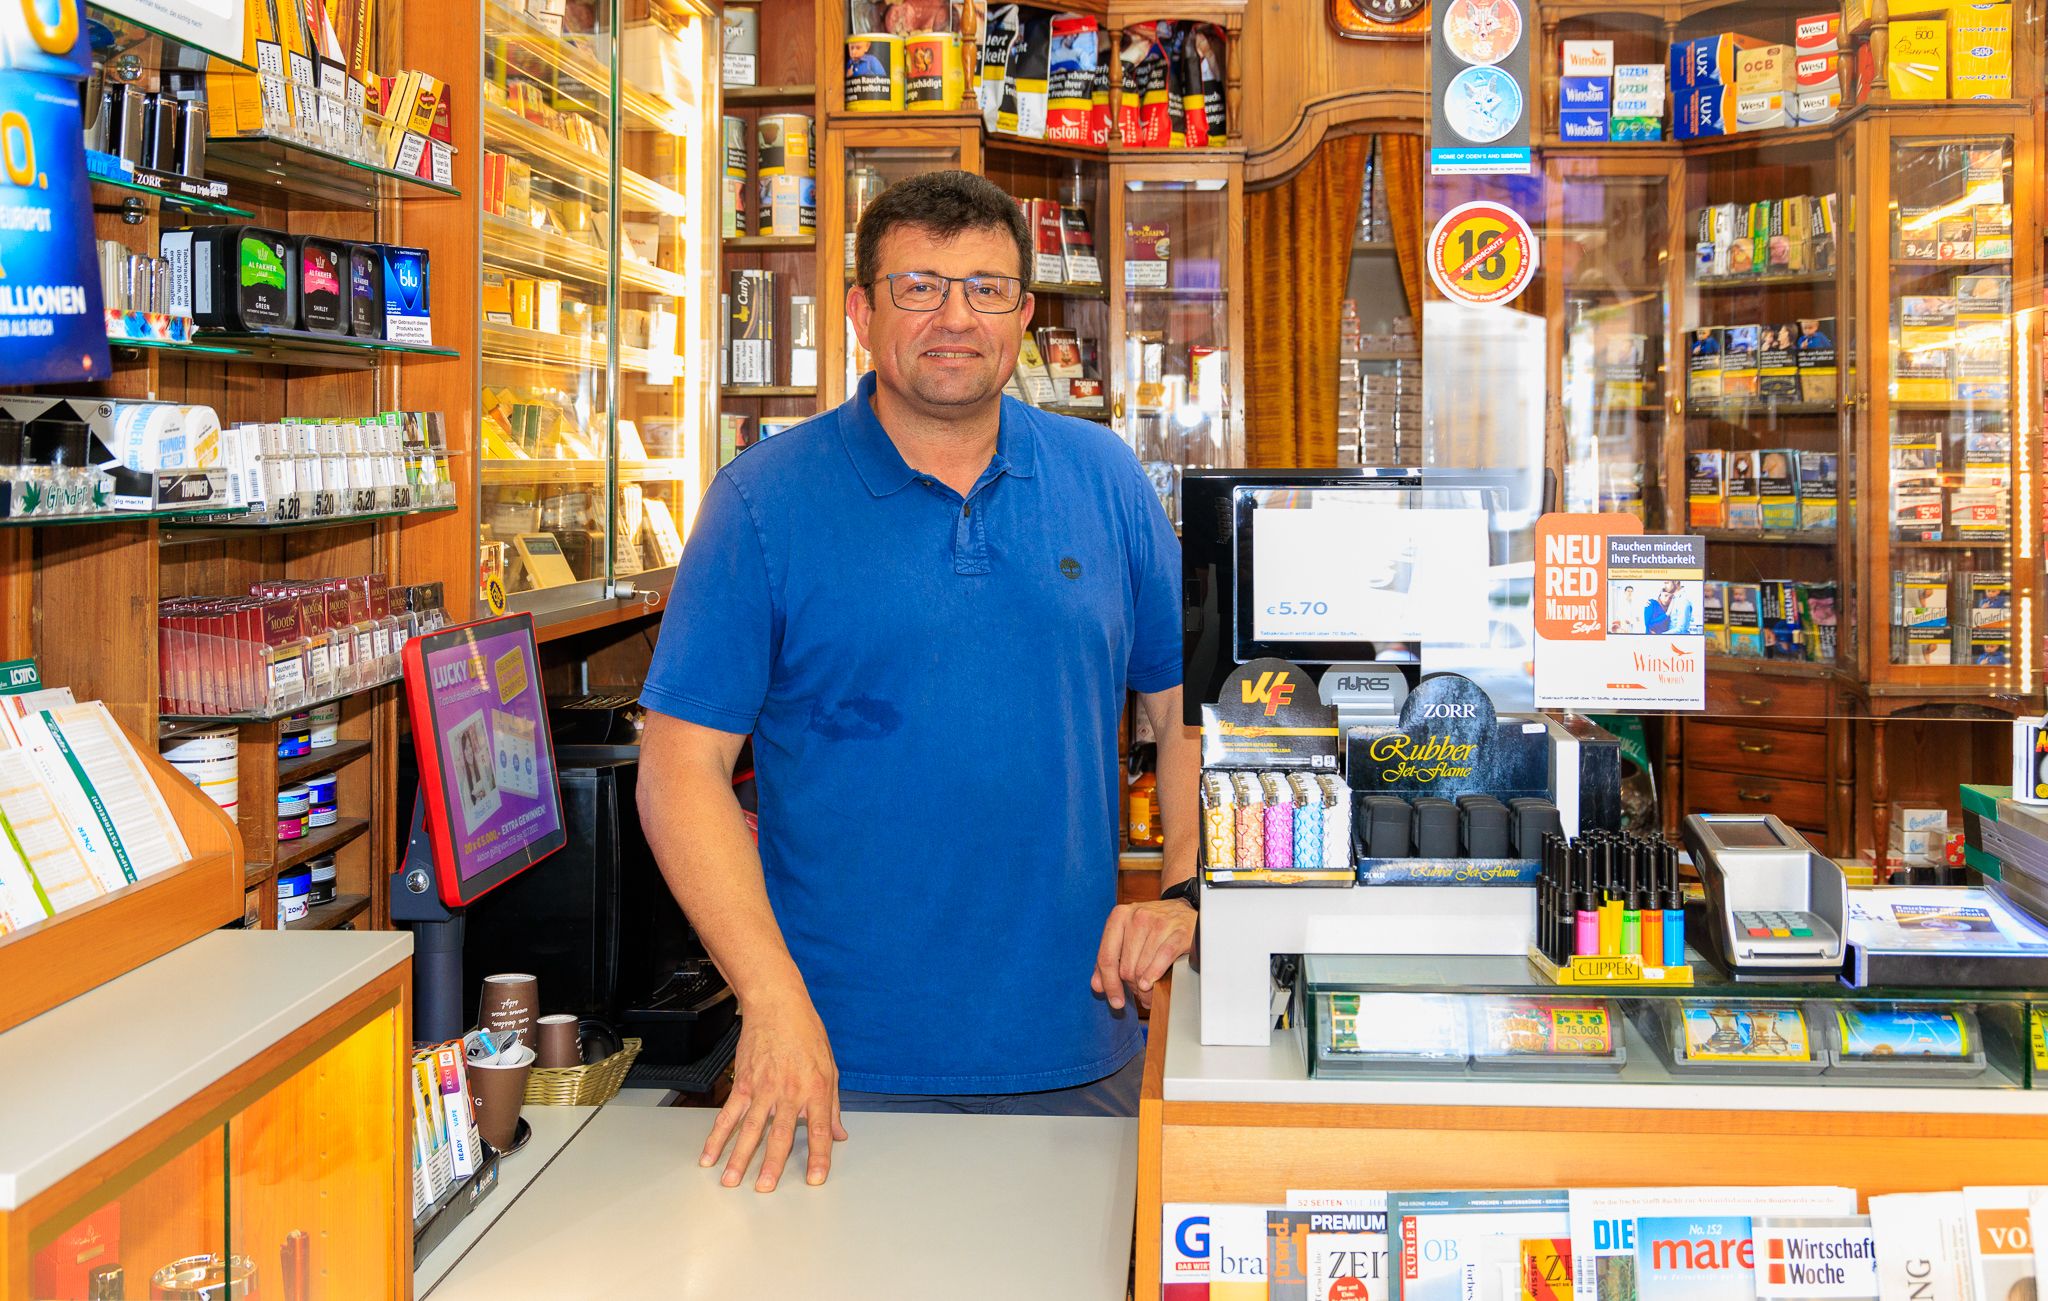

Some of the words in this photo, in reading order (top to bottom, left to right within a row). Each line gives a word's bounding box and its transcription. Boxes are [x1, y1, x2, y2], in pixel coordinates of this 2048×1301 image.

[1800, 22, 1825, 35] West
[1569, 53, 1607, 66] Winston
[1696, 46, 1708, 78] LUX
[1744, 60, 1774, 73] OCB
[1800, 61, 1824, 73] West
[1618, 67, 1649, 77] GIZEH
[861, 76, 891, 85] Rauchern
[862, 84, 881, 93] selbst
[881, 85, 890, 93] zu
[912, 78, 943, 89] schädigt
[1618, 83, 1648, 94] GIZEH
[1565, 87, 1605, 102] Winston
[1617, 99, 1647, 110] GIZEH
[1700, 95, 1712, 126] LUX
[1740, 99, 1766, 111] West
[1802, 98, 1825, 109] West
[1565, 122, 1604, 137] Winston
[136, 172, 162, 188] ZORR
[1437, 231, 1449, 247] Kein
[1436, 246, 1446, 272] Verkauf
[1458, 229, 1507, 281] 18
[1460, 237, 1505, 274] JUGENDSCHUTZ
[248, 261, 257, 270] AL
[257, 261, 277, 272] FAKHER
[394, 260, 407, 275] my
[399, 269, 418, 288] blu
[737, 275, 751, 305] Curly
[255, 302, 270, 311] GREEN
[258, 295, 267, 303] BIG
[398, 318, 415, 327] Gebrauch
[46, 484, 89, 510] Grinder
[1545, 534, 1601, 565] NEU
[1611, 541, 1652, 552] Rauchen
[1653, 541, 1693, 552] mindert
[1611, 554, 1630, 564] Ihre
[1632, 554, 1696, 565] Fruchtbarkeit
[1545, 566, 1599, 596] RED
[1279, 601, 1329, 615] 5.70
[1784, 587, 1795, 625] DRUM
[271, 615, 296, 631] MOODS
[1633, 650, 1695, 673] Winston
[10, 666, 38, 687] LOTTO
[433, 659, 467, 689] LUCKY
[1337, 676, 1390, 691] AURES
[1423, 703, 1477, 718] ZORR
[1369, 733, 1477, 762] Rubber
[1382, 761, 1473, 783] Jet-Flame
[90, 795, 119, 847] ÖSTERREICH!
[501, 819, 519, 835] EXTRA
[518, 804, 547, 827] GEWINNEN!
[76, 826, 97, 854] JOKER
[116, 848, 131, 873] TIPPT
[1410, 865, 1454, 878] Rubber
[1454, 865, 1521, 881] Jet-Flame
[1578, 963, 1633, 976] CLIPPER
[456, 1138, 465, 1162] READY
[1310, 1199, 1343, 1207] SEITEN
[1310, 1214, 1386, 1231] PREMIUM
[1688, 1224, 1705, 1235] No.
[1706, 1224, 1723, 1235] 152
[1405, 1219, 1416, 1277] KURIER
[1424, 1239, 1458, 1262] OB
[1652, 1239, 1755, 1270] mare
[1788, 1262, 1845, 1285] Woche
